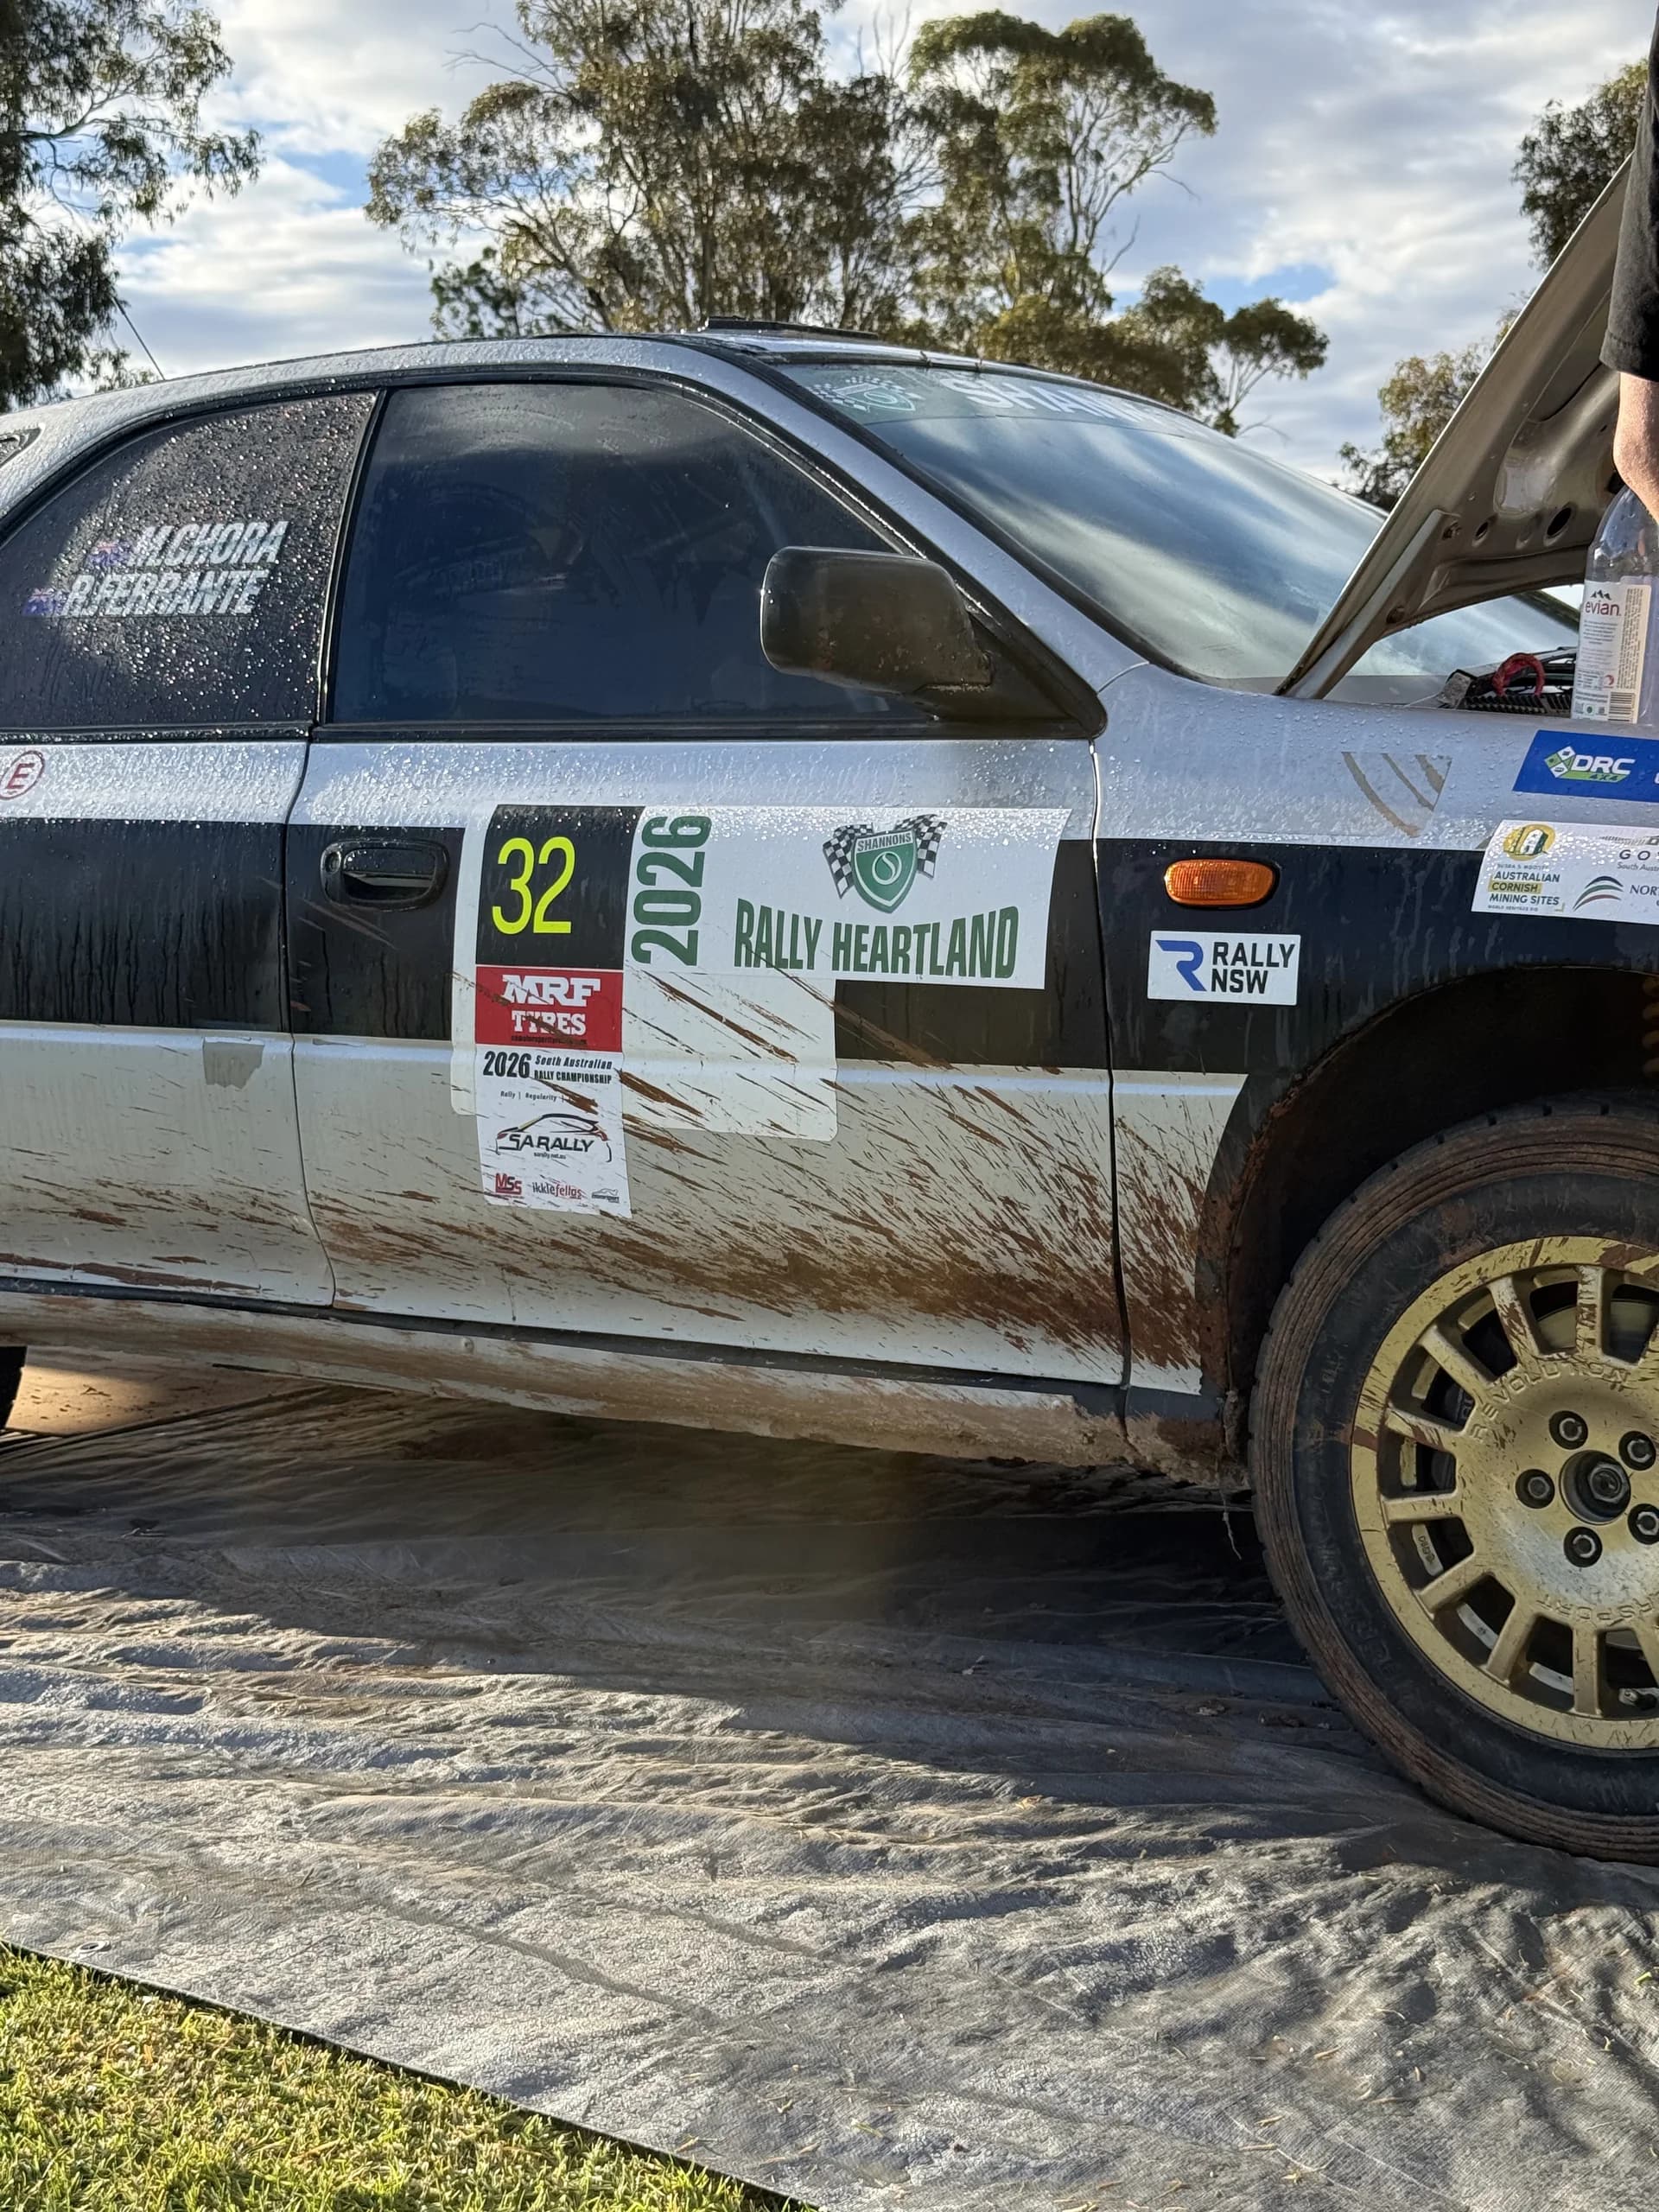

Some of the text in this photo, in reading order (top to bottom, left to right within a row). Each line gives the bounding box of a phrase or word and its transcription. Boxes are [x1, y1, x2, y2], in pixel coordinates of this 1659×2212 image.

[1585, 601, 1622, 617] evian
[1570, 754, 1636, 775] DRC
[5, 763, 35, 790] E
[856, 833, 912, 852] SHANNONS
[1618, 849, 1659, 862] GO
[1617, 861, 1638, 870] South
[492, 836, 575, 935] 32
[1494, 870, 1560, 883] AUSTRALIAN
[631, 815, 713, 967] 2026
[1491, 882, 1538, 893] CORNISH
[1629, 884, 1659, 896] NOR
[1489, 893, 1560, 906] MINING SITES
[734, 898, 1019, 980] RALLY HEARTLAND
[1212, 941, 1295, 969] RALLY
[500, 974, 601, 1007] MRF
[1211, 969, 1268, 995] NSW
[482, 1050, 532, 1079] 2026
[535, 1054, 613, 1071] South Australian
[534, 1070, 613, 1084] RALLY CHAMPIONSHIP
[500, 1090, 558, 1103] Rally Regularity
[498, 1133, 595, 1153] SARALLY
